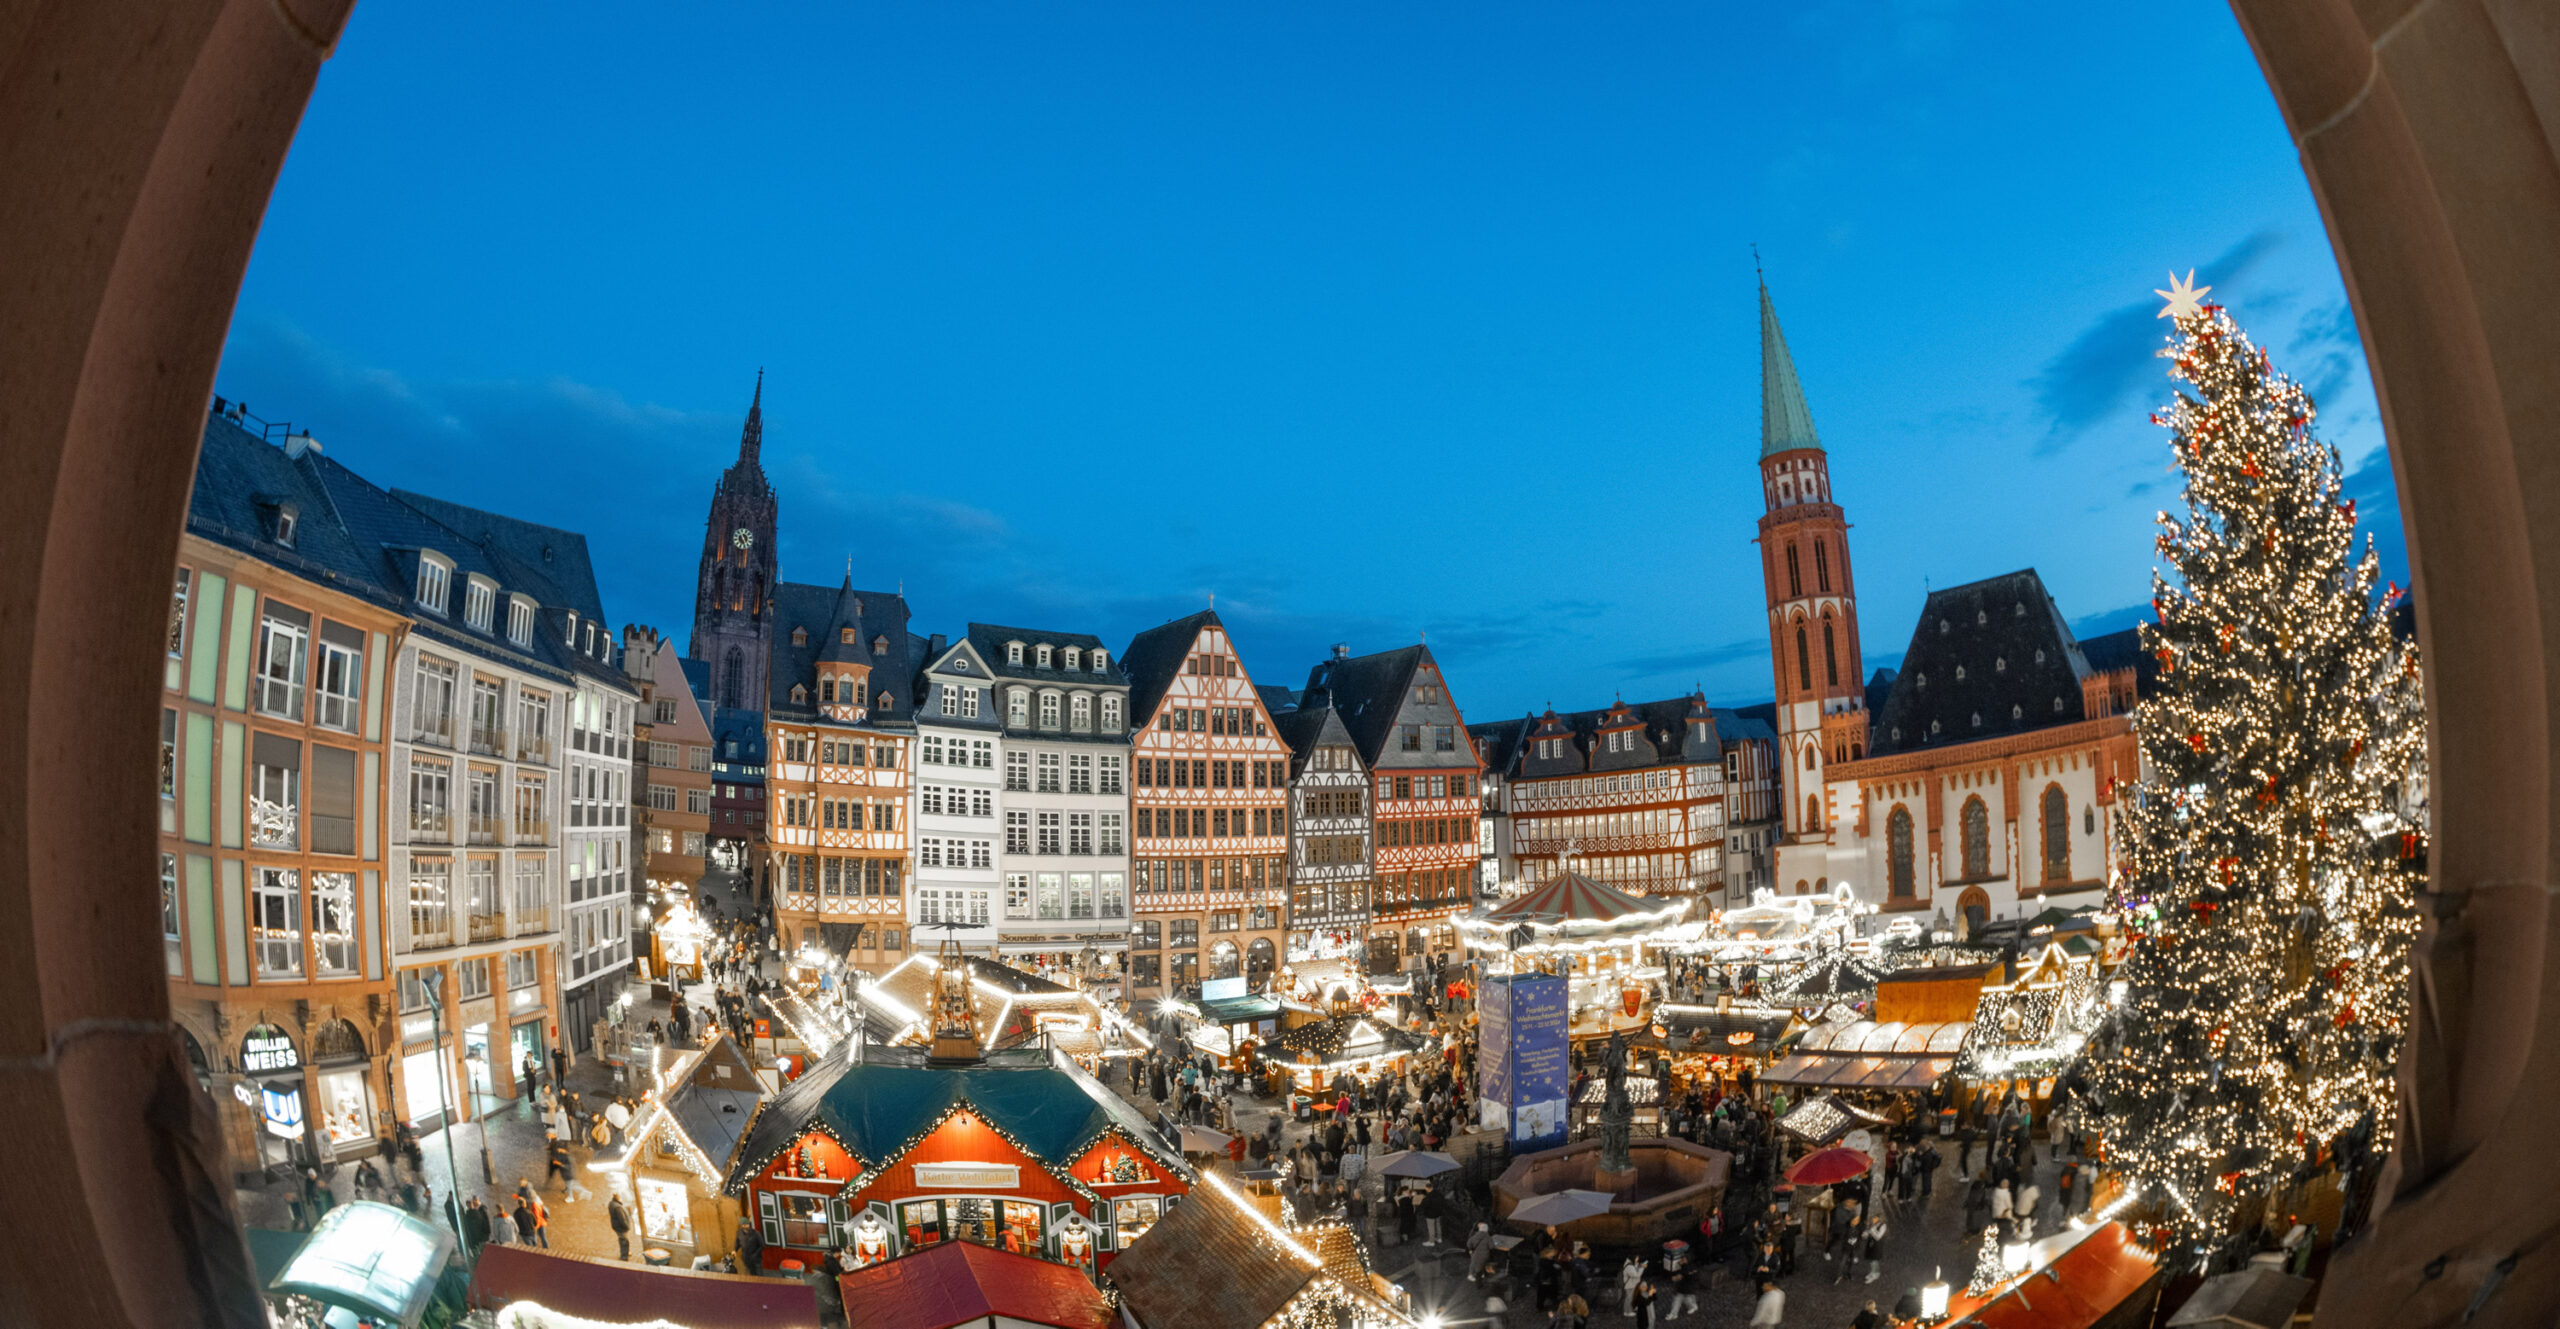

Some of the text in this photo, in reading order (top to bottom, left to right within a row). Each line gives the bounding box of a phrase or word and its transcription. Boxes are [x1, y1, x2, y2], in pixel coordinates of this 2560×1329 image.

[1003, 934, 1046, 942] Souvenirs
[247, 1037, 290, 1052] BRILLEN
[244, 1050, 297, 1071] WEISS
[262, 1089, 288, 1122] U
